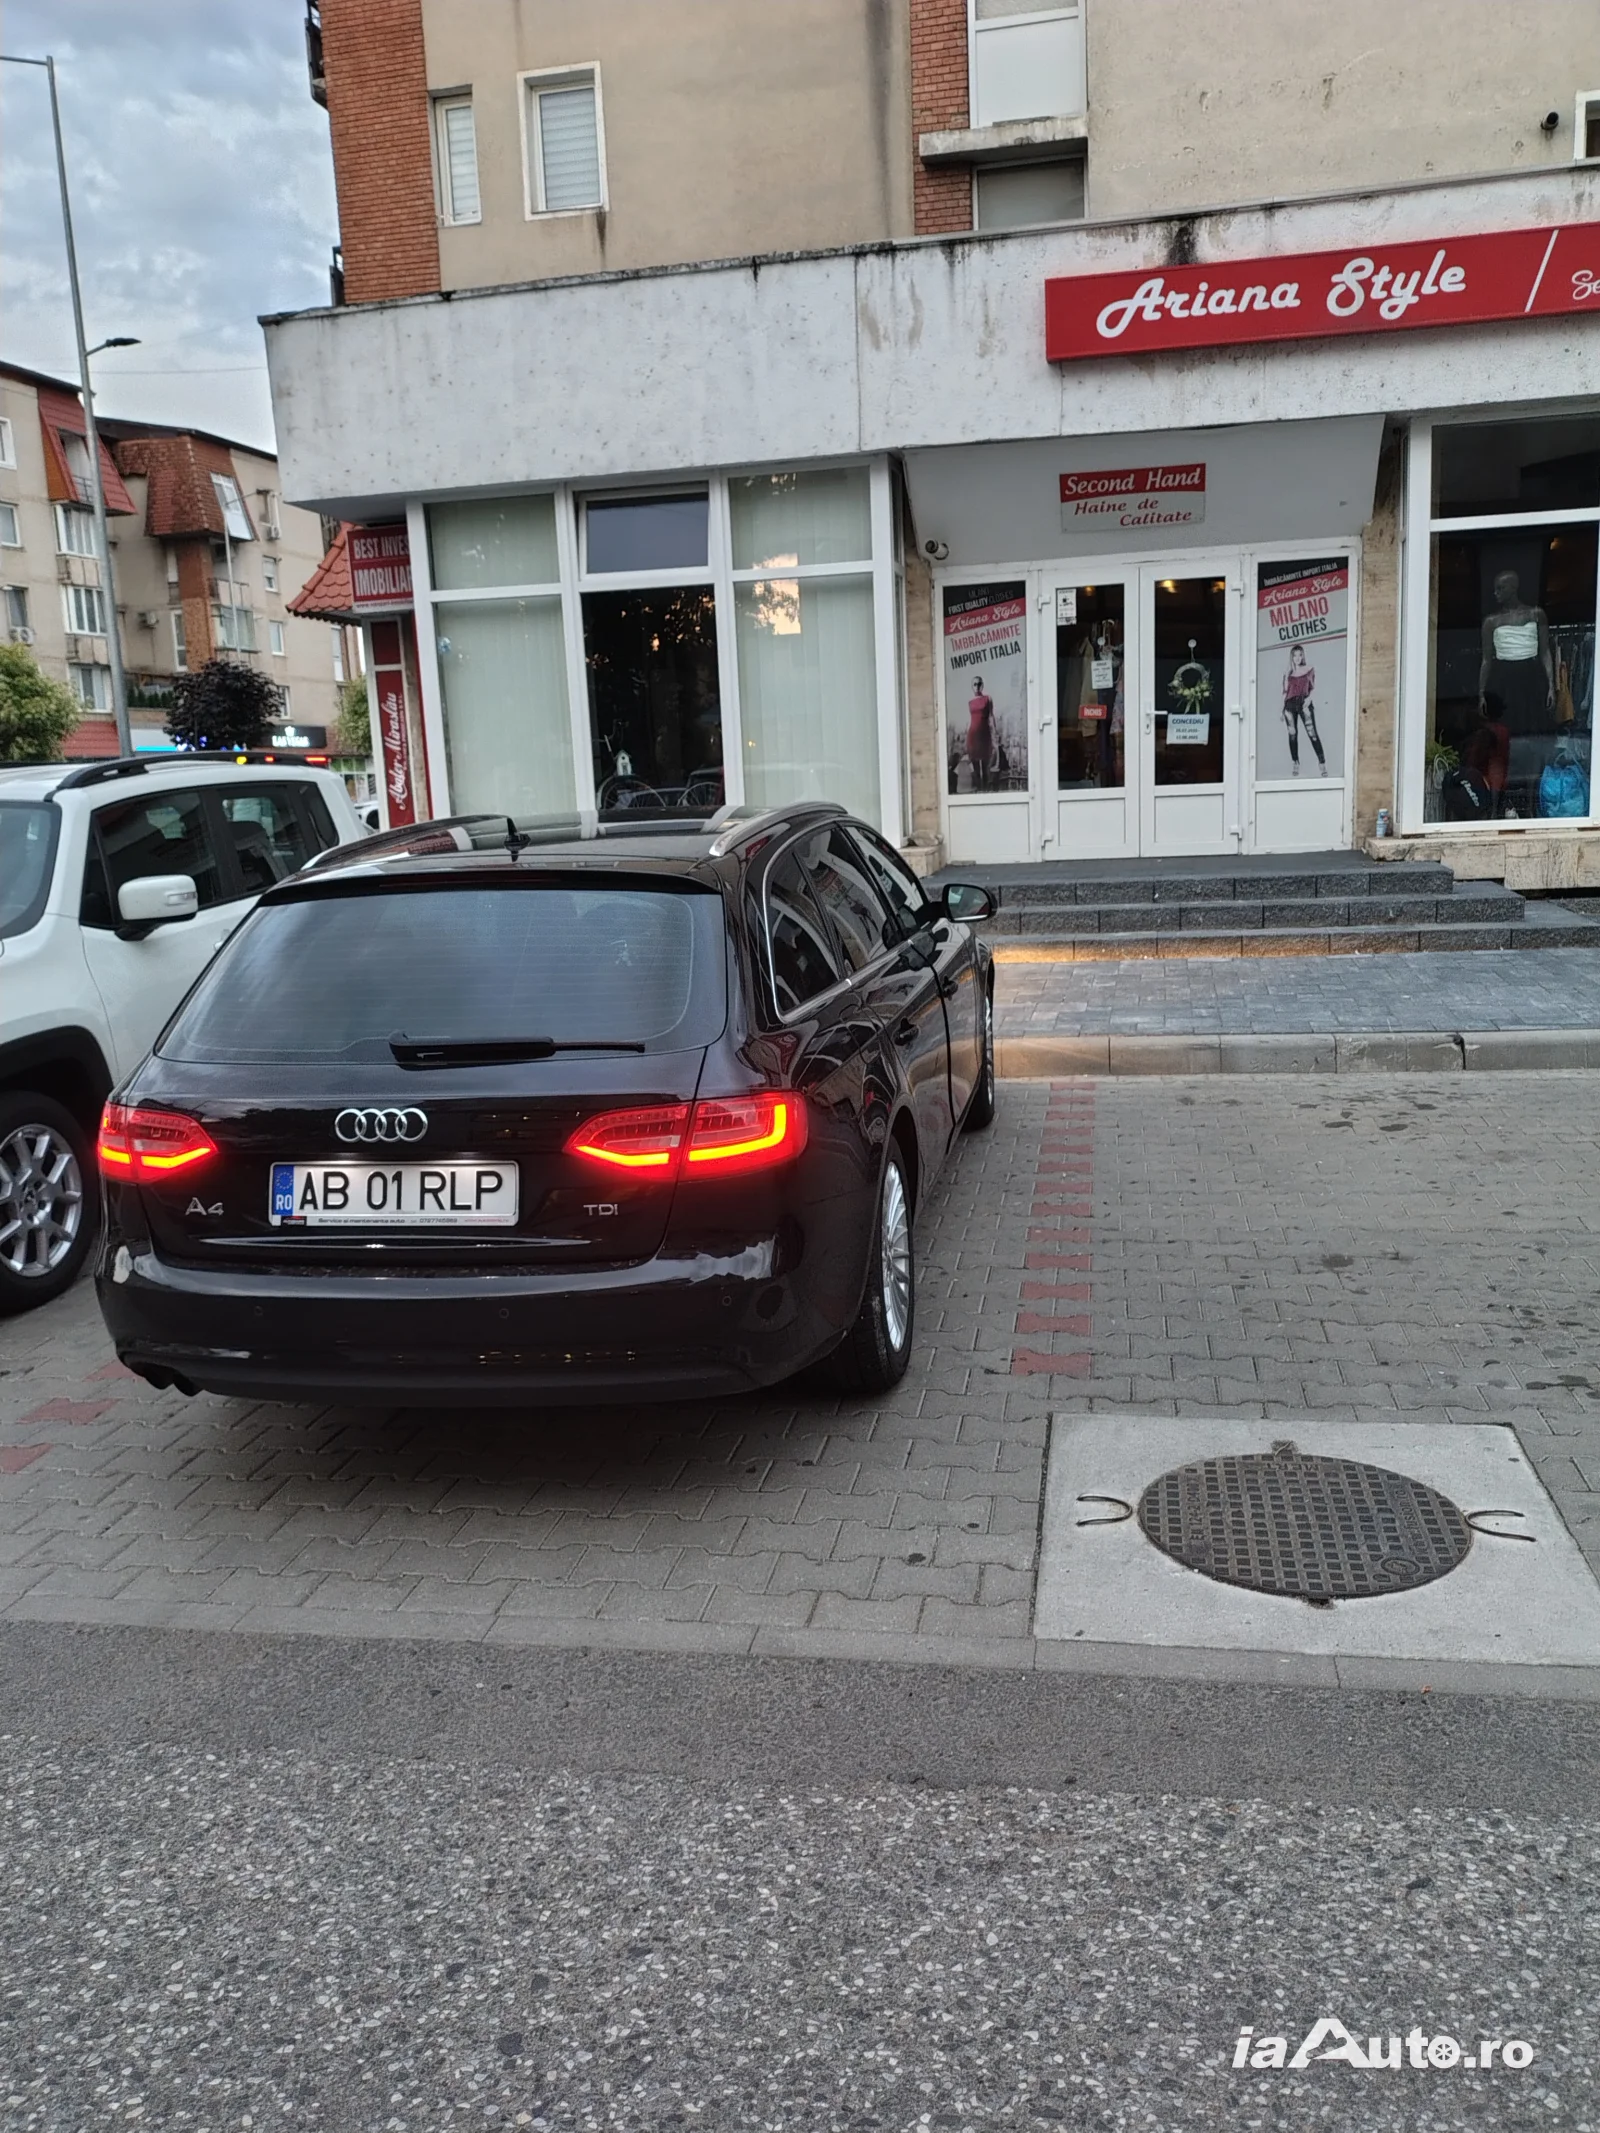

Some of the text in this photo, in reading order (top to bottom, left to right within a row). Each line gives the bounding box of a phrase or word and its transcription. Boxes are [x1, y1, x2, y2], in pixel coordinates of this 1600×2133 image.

[1096, 248, 1467, 339] Ariana Style
[1064, 467, 1201, 495] Second Hand
[1074, 498, 1159, 516] Haine de
[1119, 511, 1192, 527] Calitate
[353, 537, 380, 560] BEST
[1302, 565, 1321, 577] IMPORT
[1321, 562, 1338, 573] ITALIA
[1263, 575, 1343, 606] Ariana Style
[948, 596, 988, 615] FIRST QUALITY
[1269, 596, 1329, 628] MILANO
[949, 603, 1021, 633] Ariana Style
[1278, 617, 1327, 641] CLOTHES
[951, 623, 1021, 652] ÎMBRĂCĂMINTE
[950, 641, 1021, 670] IMPORT ITALIA
[275, 1194, 293, 1211] RO
[299, 1170, 503, 1211] AB 01 RLP
[185, 1197, 225, 1217] A4
[583, 1203, 619, 1216] TDI
